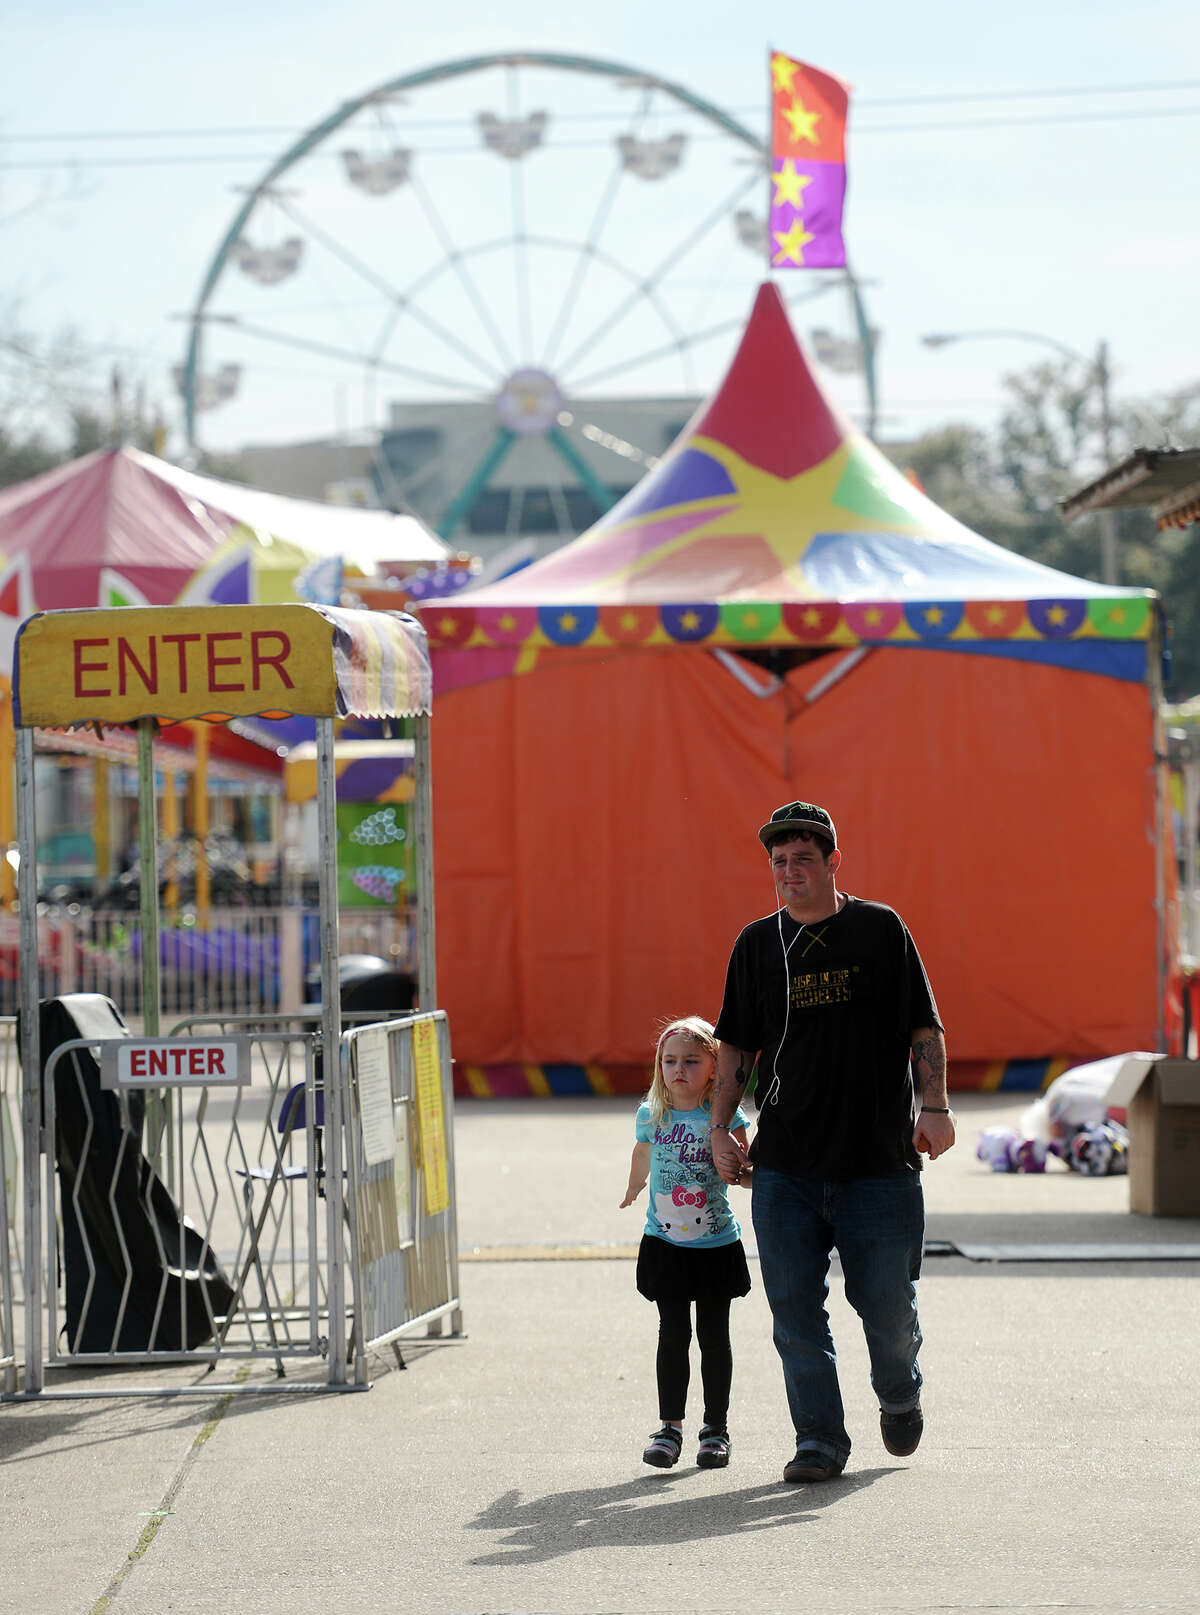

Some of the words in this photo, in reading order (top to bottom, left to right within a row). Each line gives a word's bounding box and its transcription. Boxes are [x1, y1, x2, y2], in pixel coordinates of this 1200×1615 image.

[73, 630, 295, 698] ENTER
[820, 971, 830, 985] IN
[130, 1048, 226, 1077] ENTER
[654, 1123, 698, 1145] hello
